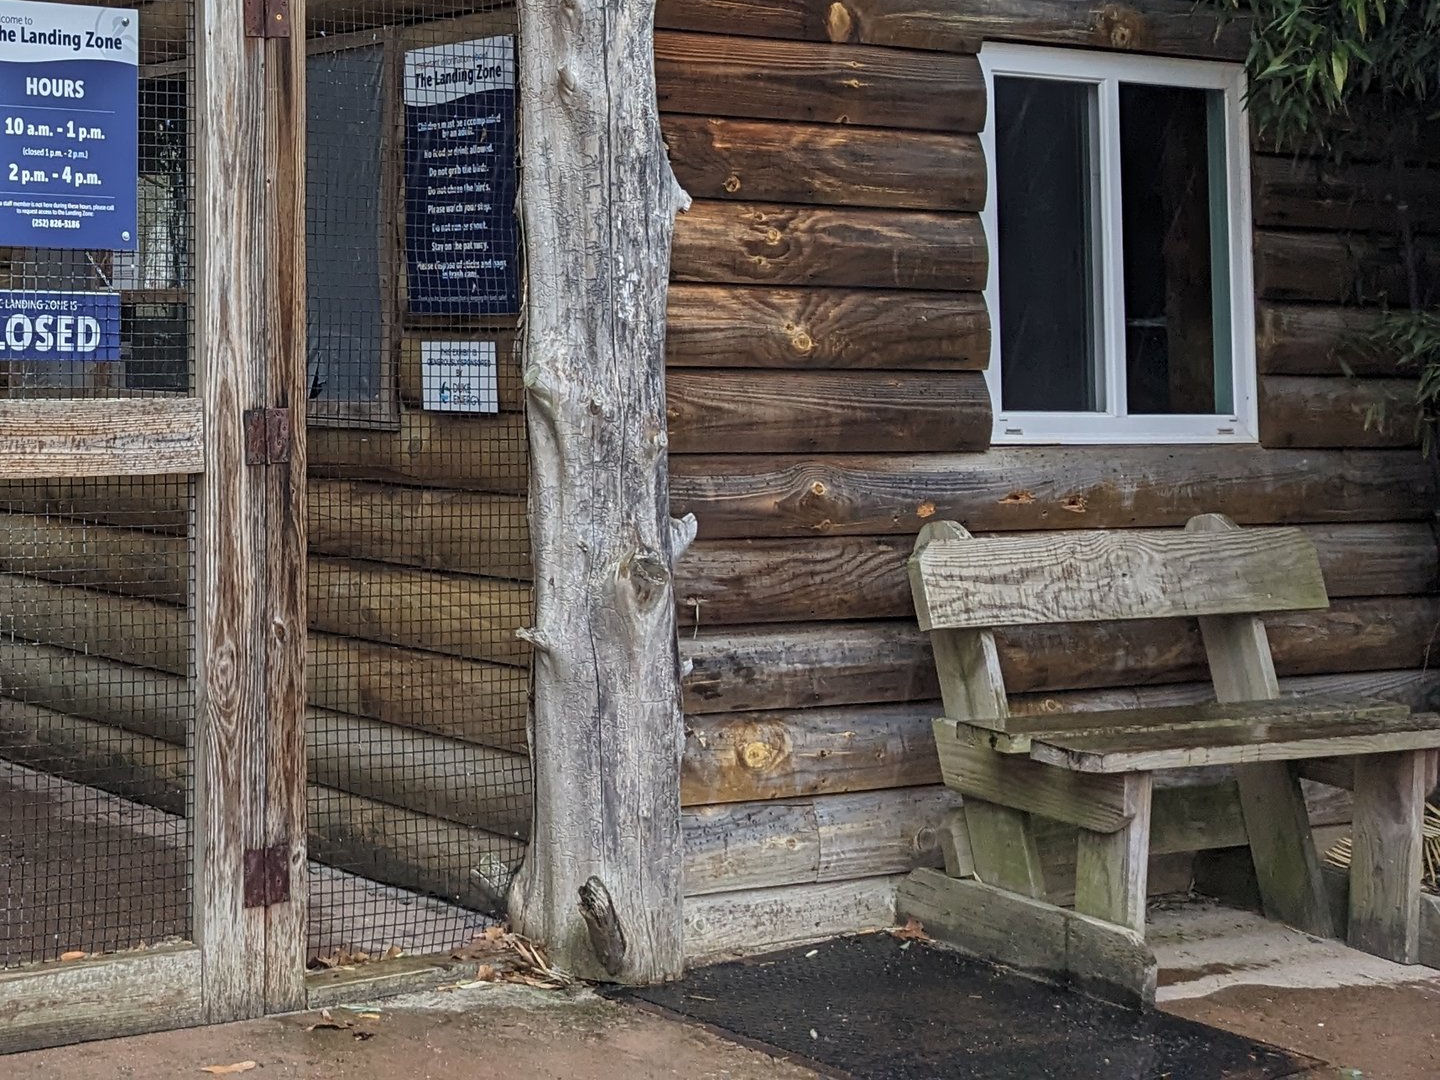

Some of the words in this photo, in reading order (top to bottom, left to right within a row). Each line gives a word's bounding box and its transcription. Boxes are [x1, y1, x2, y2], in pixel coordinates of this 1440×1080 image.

[25, 16, 33, 25] to
[21, 26, 81, 51] Landing
[85, 31, 122, 50] Zone
[415, 73, 432, 88] The
[434, 67, 474, 86] Landing
[476, 64, 502, 80] Zone
[26, 77, 85, 98] HOURS
[5, 117, 24, 135] 10
[27, 124, 54, 137] a.m.
[66, 120, 76, 138] 1
[78, 127, 105, 142] p.m.
[22, 147, 44, 157] (closed
[50, 150, 63, 159] p.m.
[68, 149, 73, 157] 2
[73, 150, 89, 159] p.m.)
[8, 163, 19, 181] 2
[21, 170, 49, 185] p.m.
[62, 166, 72, 183] 4
[75, 172, 102, 187] p.m.
[429, 167, 437, 177] Do
[437, 167, 448, 176] not
[428, 186, 436, 195] Do
[437, 186, 447, 195] not
[427, 204, 445, 214] Please
[32, 218, 49, 228] (252)
[432, 223, 440, 232] Do
[441, 223, 451, 232] not
[432, 242, 444, 251] Stay
[445, 243, 452, 251] on
[480, 259, 492, 268] and
[5, 299, 43, 310] LANDING
[45, 300, 68, 311] ZONE
[70, 301, 78, 311] IS
